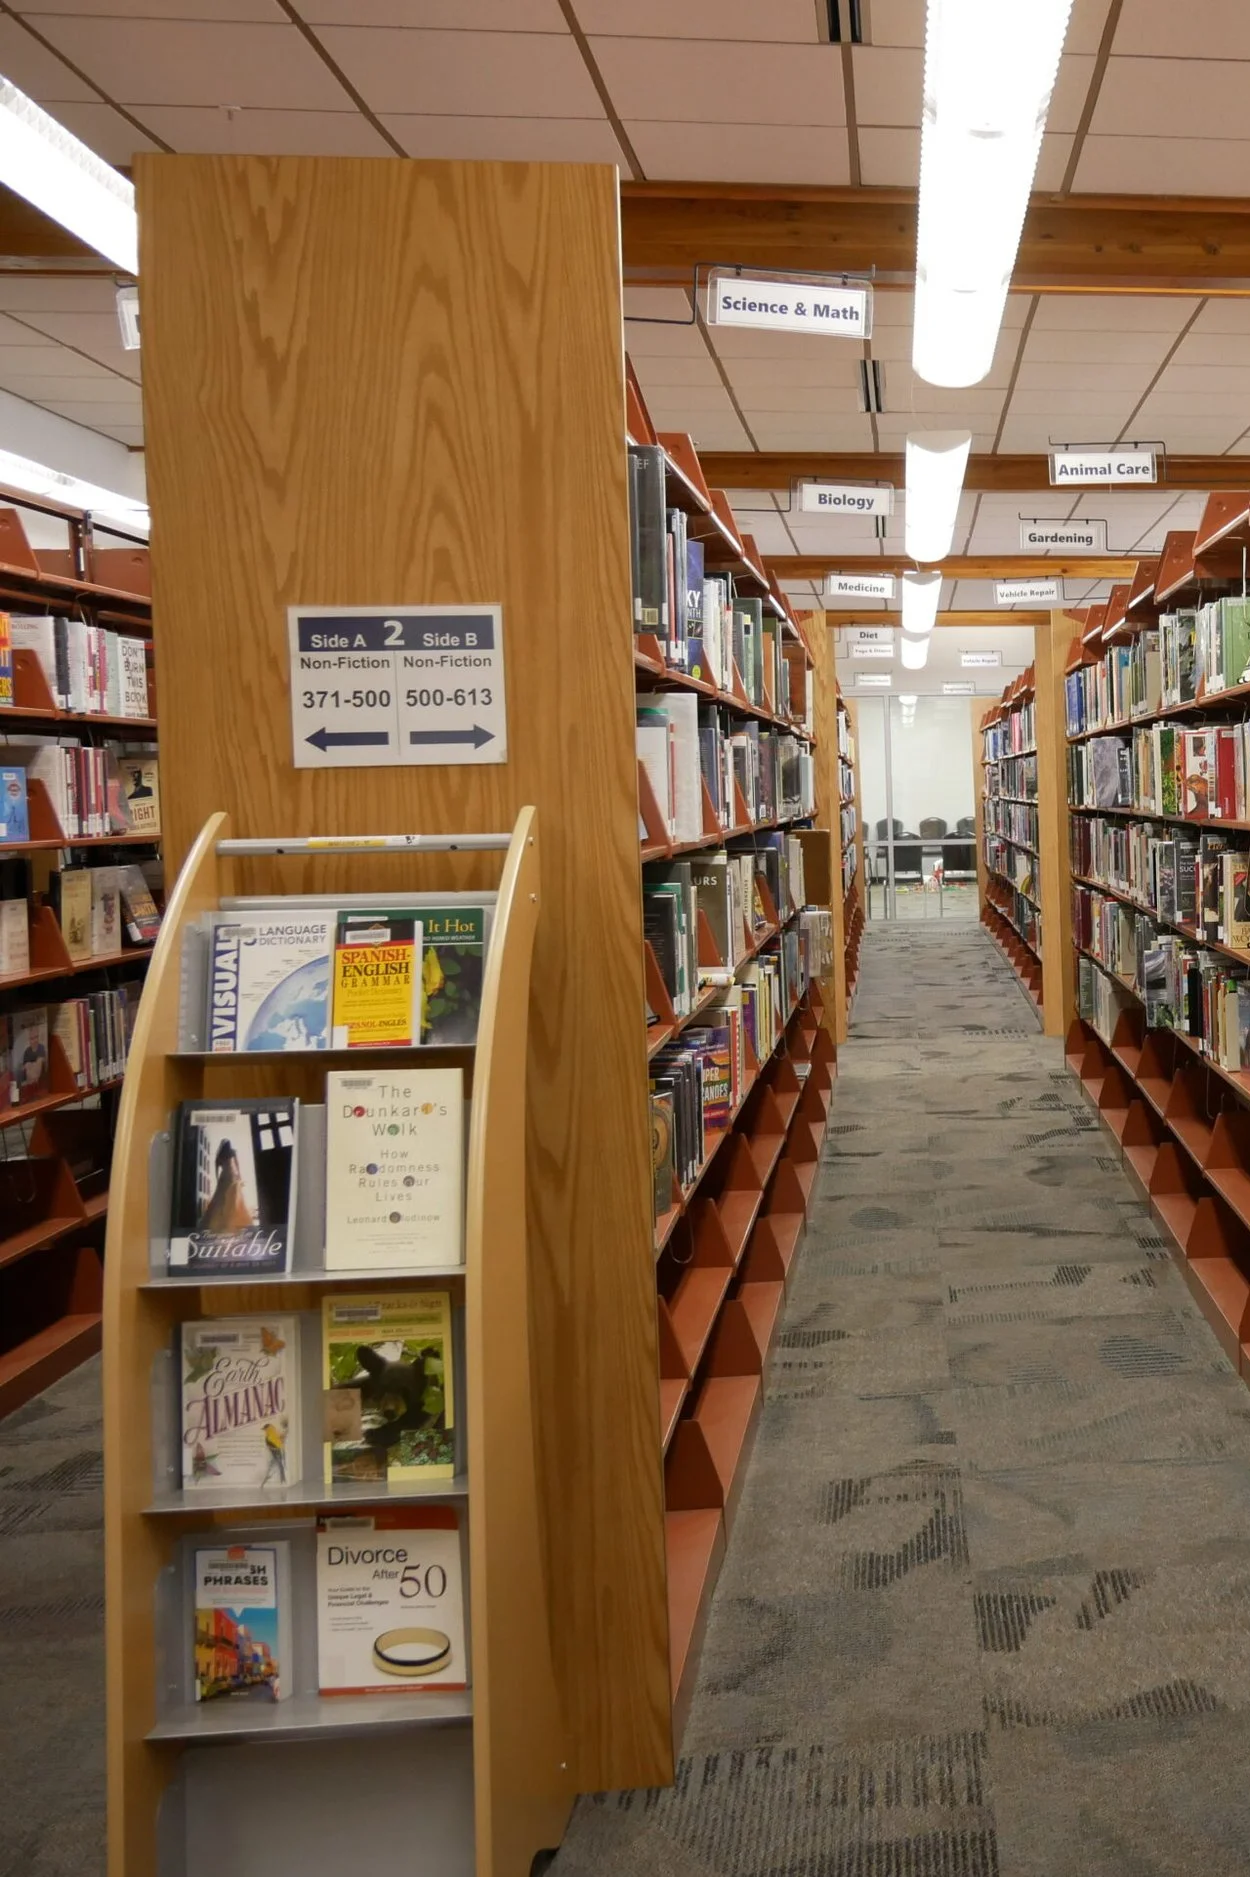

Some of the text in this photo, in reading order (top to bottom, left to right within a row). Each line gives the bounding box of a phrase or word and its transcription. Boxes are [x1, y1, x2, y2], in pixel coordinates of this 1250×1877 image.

[722, 296, 859, 321] Science & Math
[1058, 461, 1150, 477] Animal Care
[817, 493, 875, 510] Biology
[1028, 532, 1094, 546] Gardening
[838, 582, 885, 593] Medicine
[1000, 589, 1055, 598] Vehicle Repair
[383, 620, 405, 646] 2
[423, 632, 478, 647] Side B
[859, 631, 878, 639] Diet
[311, 634, 367, 648] Side A
[122, 645, 145, 656] DON'T
[301, 656, 390, 670] Non-Fiction
[403, 655, 492, 668] Non-Fiction
[127, 677, 143, 688] THIS
[125, 691, 147, 703] BOOK
[303, 690, 391, 709] 371-500
[406, 688, 493, 708] 500-613
[259, 924, 327, 937] LANGUAGE
[428, 919, 475, 933] It Hot
[259, 933, 327, 946] DICTIONARY
[342, 949, 410, 964] SPANISH-
[342, 962, 409, 977] ENGLISH
[214, 925, 241, 1034] VISUAL
[341, 975, 410, 988] GRAMMAR
[379, 1085, 412, 1099] The
[380, 1148, 409, 1160] How
[358, 1176, 398, 1189] Rules
[375, 1191, 413, 1203] Lives
[347, 1214, 387, 1225] Leonard
[187, 1229, 282, 1259] Suitable
[203, 1357, 269, 1397] Earth
[184, 1376, 286, 1445] ALMANAC
[328, 1547, 408, 1565] Divorce
[204, 1576, 268, 1586] PHRASES
[372, 1564, 447, 1599] After 50
